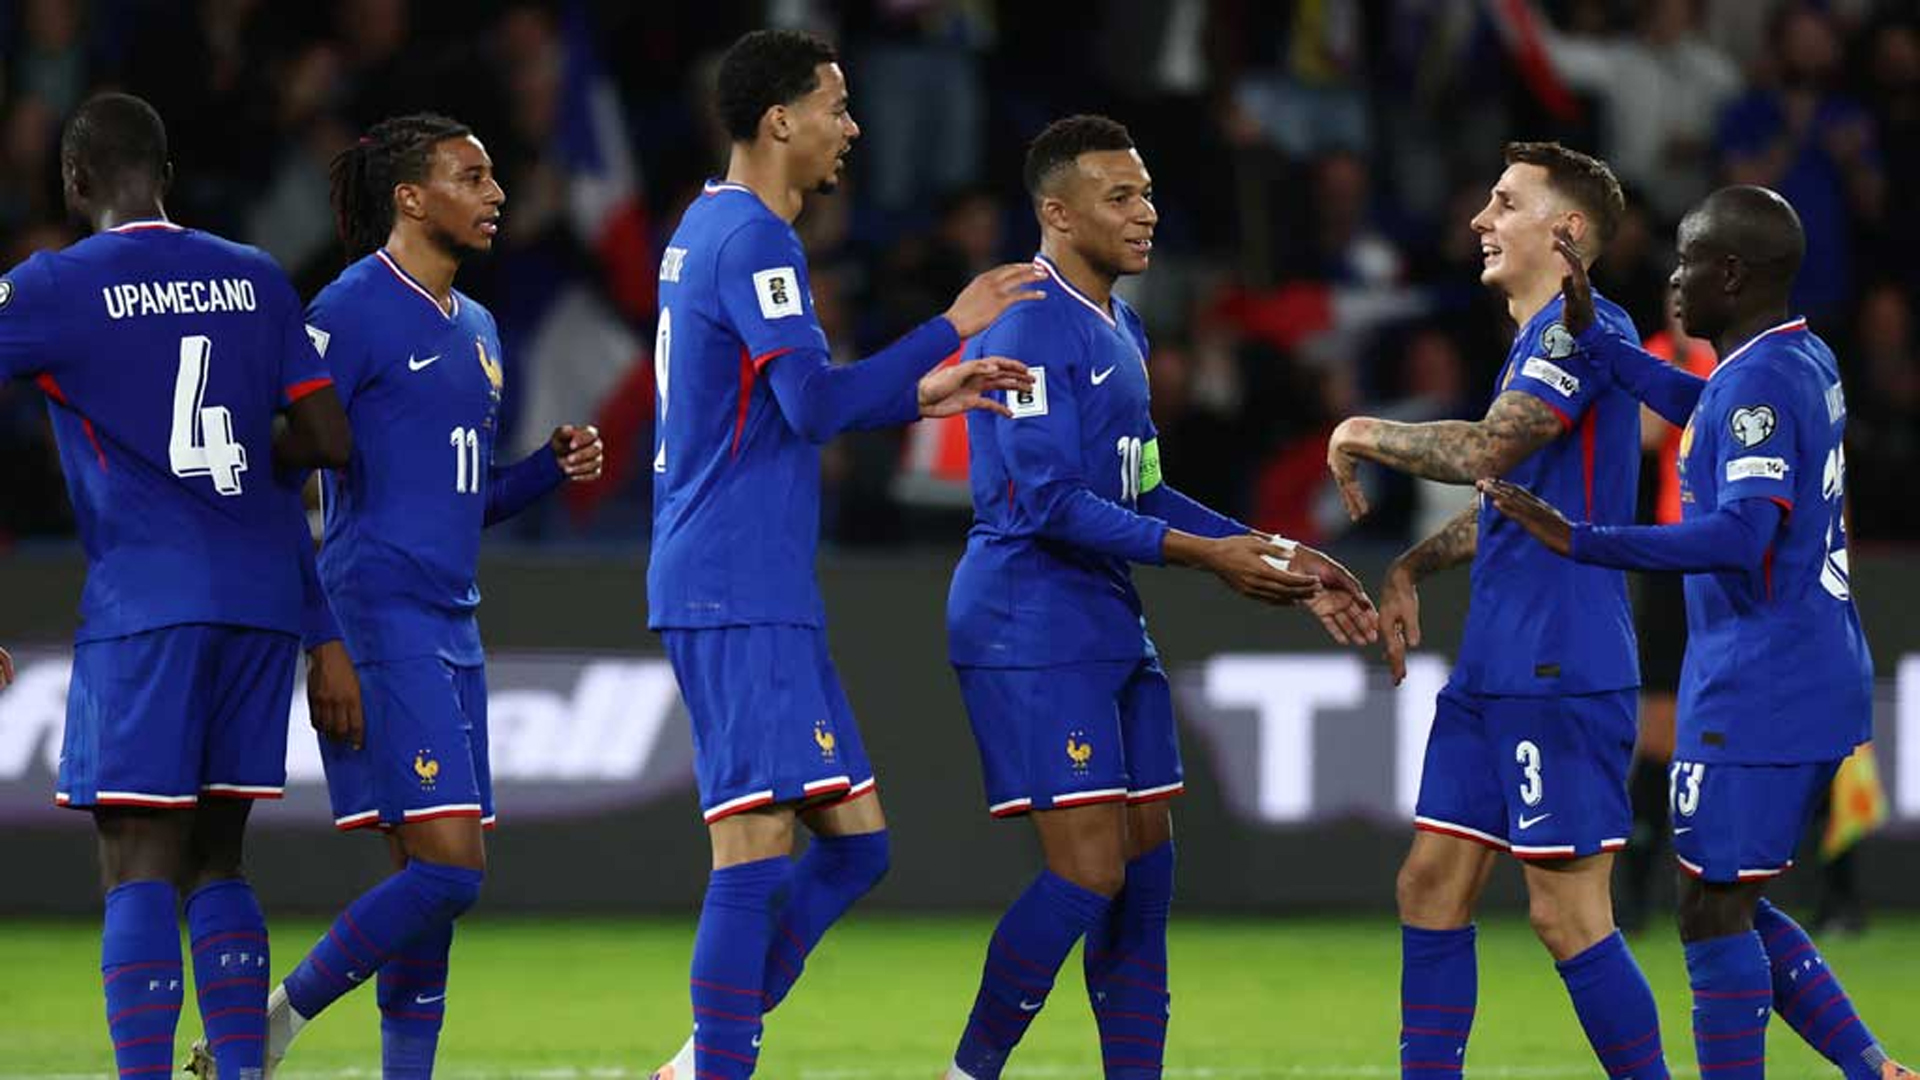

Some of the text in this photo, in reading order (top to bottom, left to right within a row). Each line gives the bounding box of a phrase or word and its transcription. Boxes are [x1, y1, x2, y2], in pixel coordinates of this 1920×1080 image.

[103, 278, 256, 319] UPAMECANO
[169, 335, 248, 495] 4
[450, 426, 478, 494] 11
[1117, 436, 1141, 505] 10
[1516, 740, 1542, 806] 3
